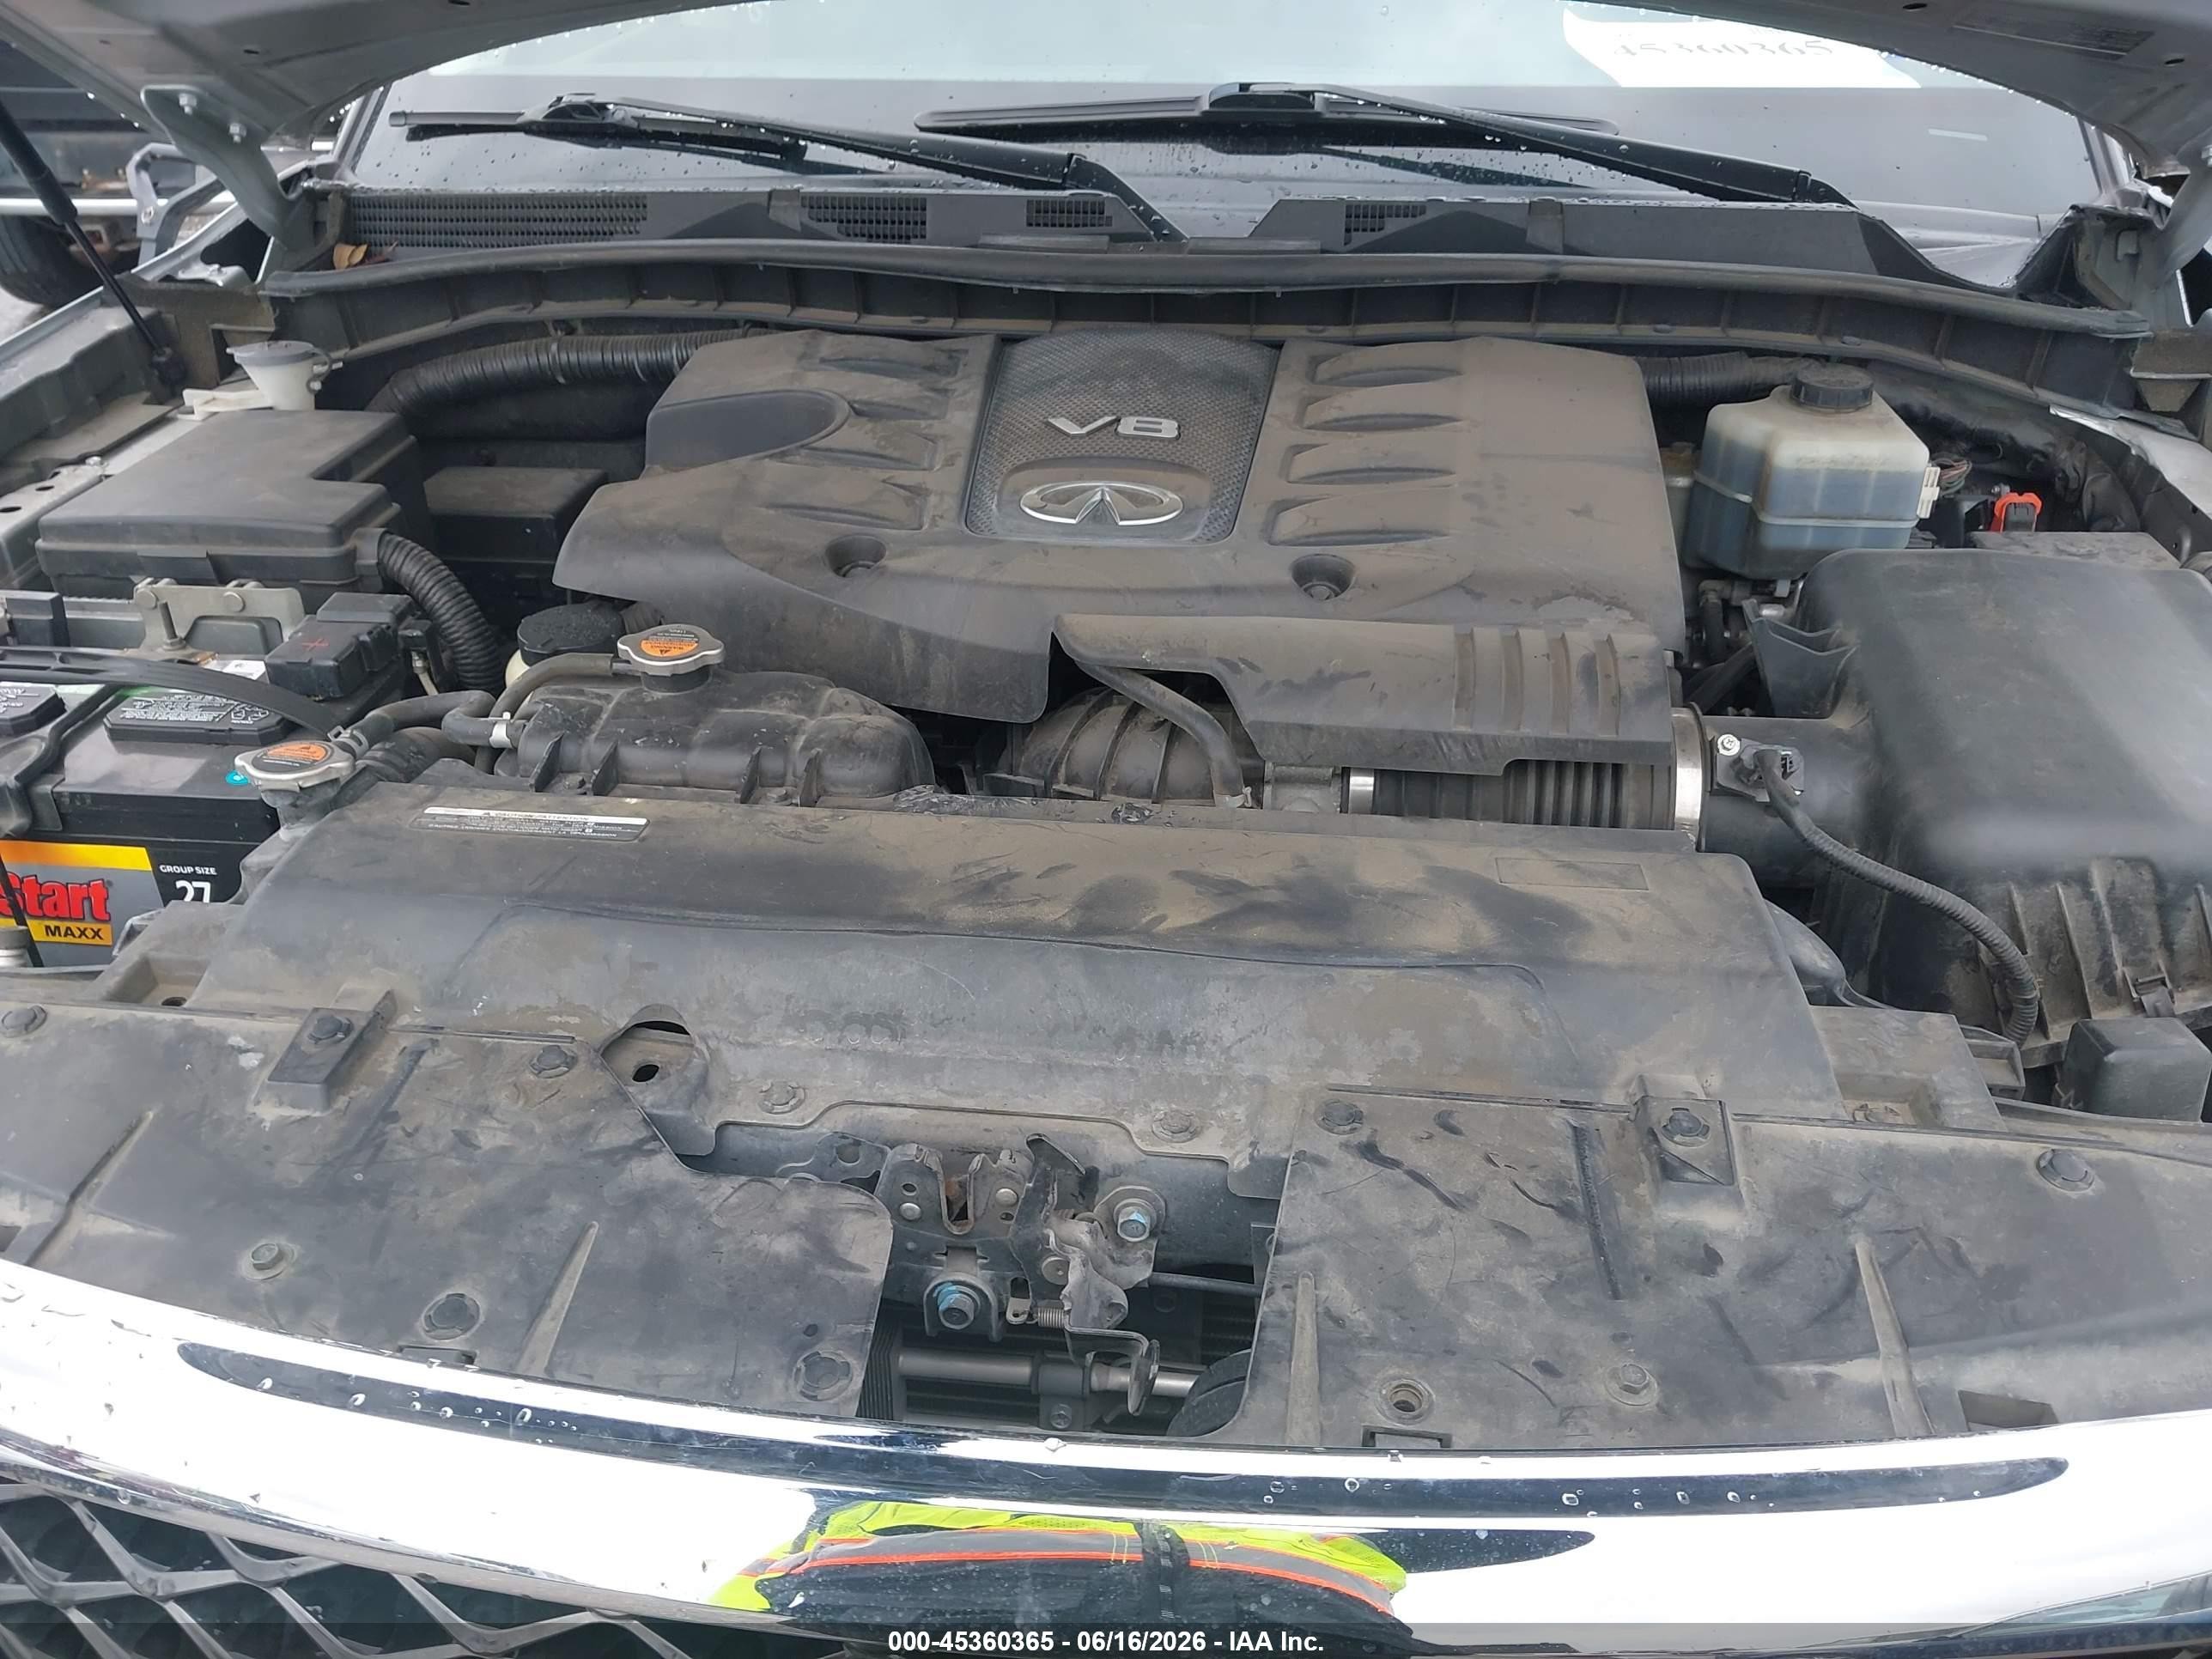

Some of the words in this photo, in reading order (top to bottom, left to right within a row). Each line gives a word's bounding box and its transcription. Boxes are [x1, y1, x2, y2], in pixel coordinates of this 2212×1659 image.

[1048, 416, 1180, 439] V8
[159, 864, 193, 874] GROUP
[196, 866, 217, 875] SIZE
[175, 879, 211, 902] 27
[44, 924, 104, 940] MAXX
